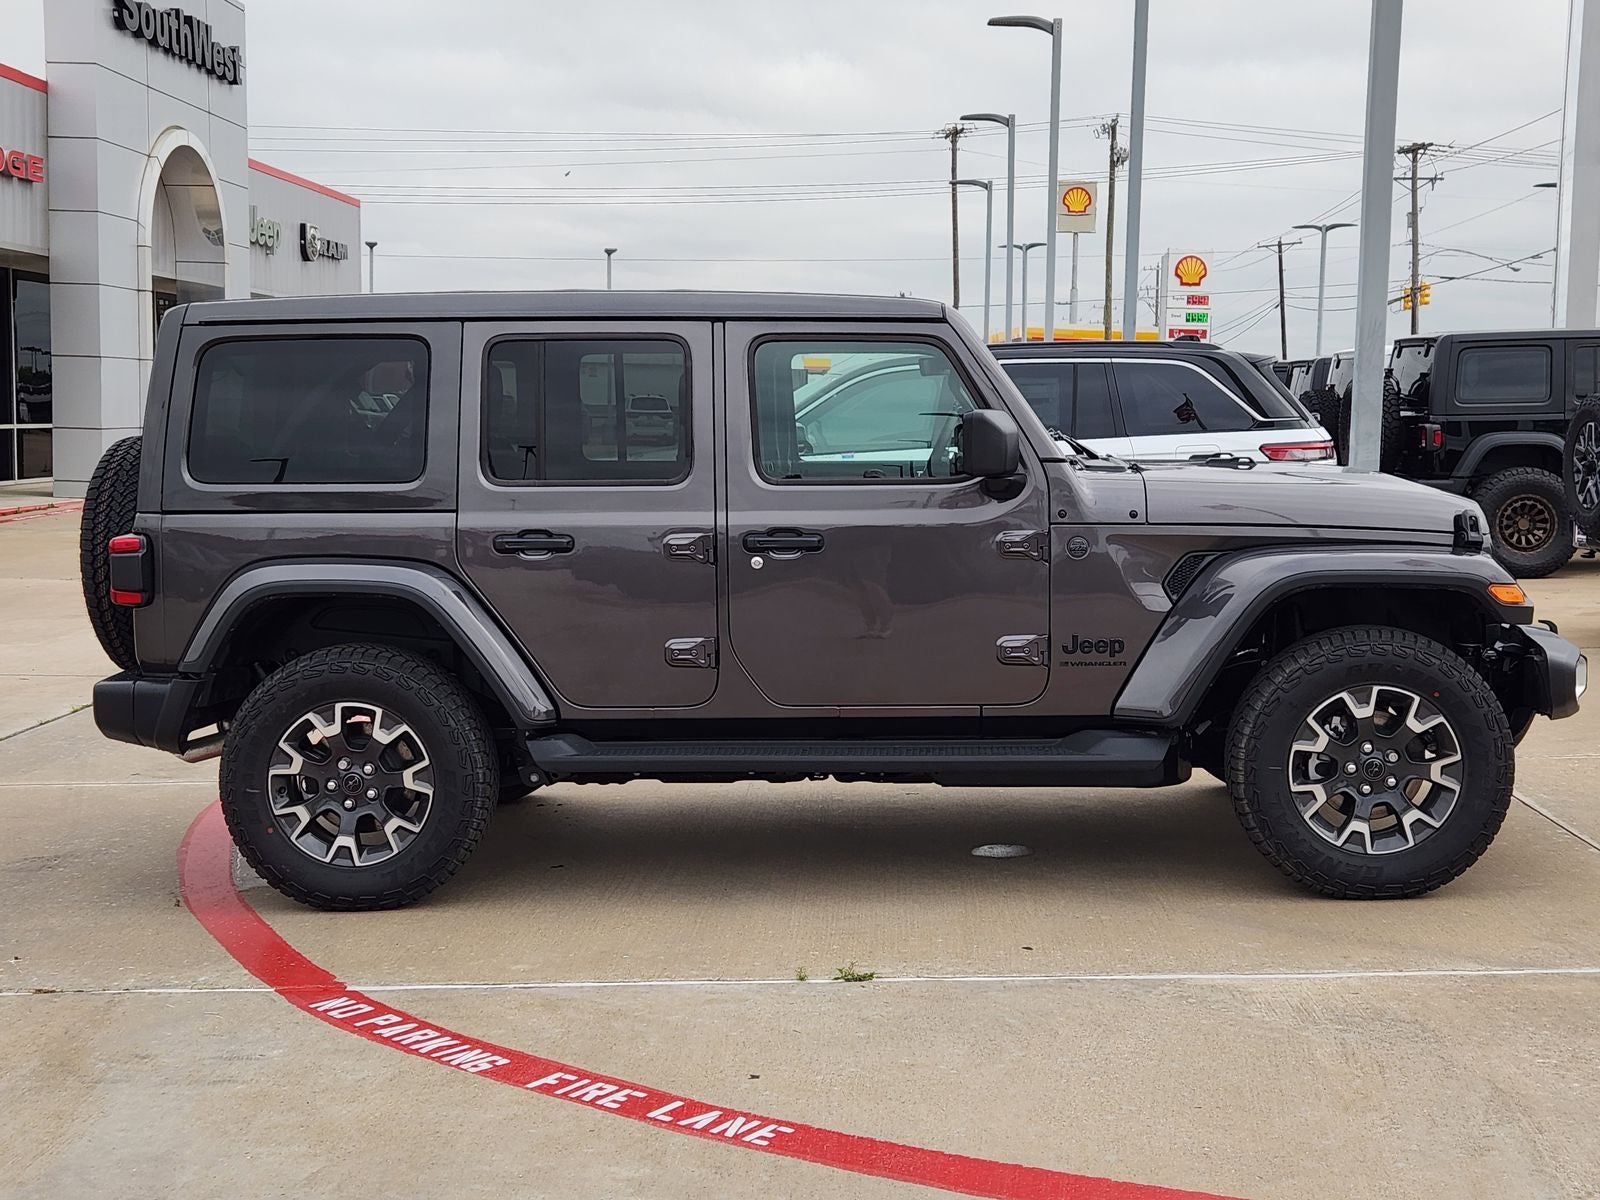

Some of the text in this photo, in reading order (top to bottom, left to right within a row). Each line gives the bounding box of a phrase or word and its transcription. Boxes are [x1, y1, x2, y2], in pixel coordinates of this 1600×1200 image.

[113, 0, 242, 85] SouthWest
[0, 145, 45, 183] GE
[249, 205, 281, 256] Jeep
[318, 238, 348, 260] RAM
[1062, 634, 1125, 658] Jeep
[308, 996, 795, 1146] NO PARKING FIRE LANE
